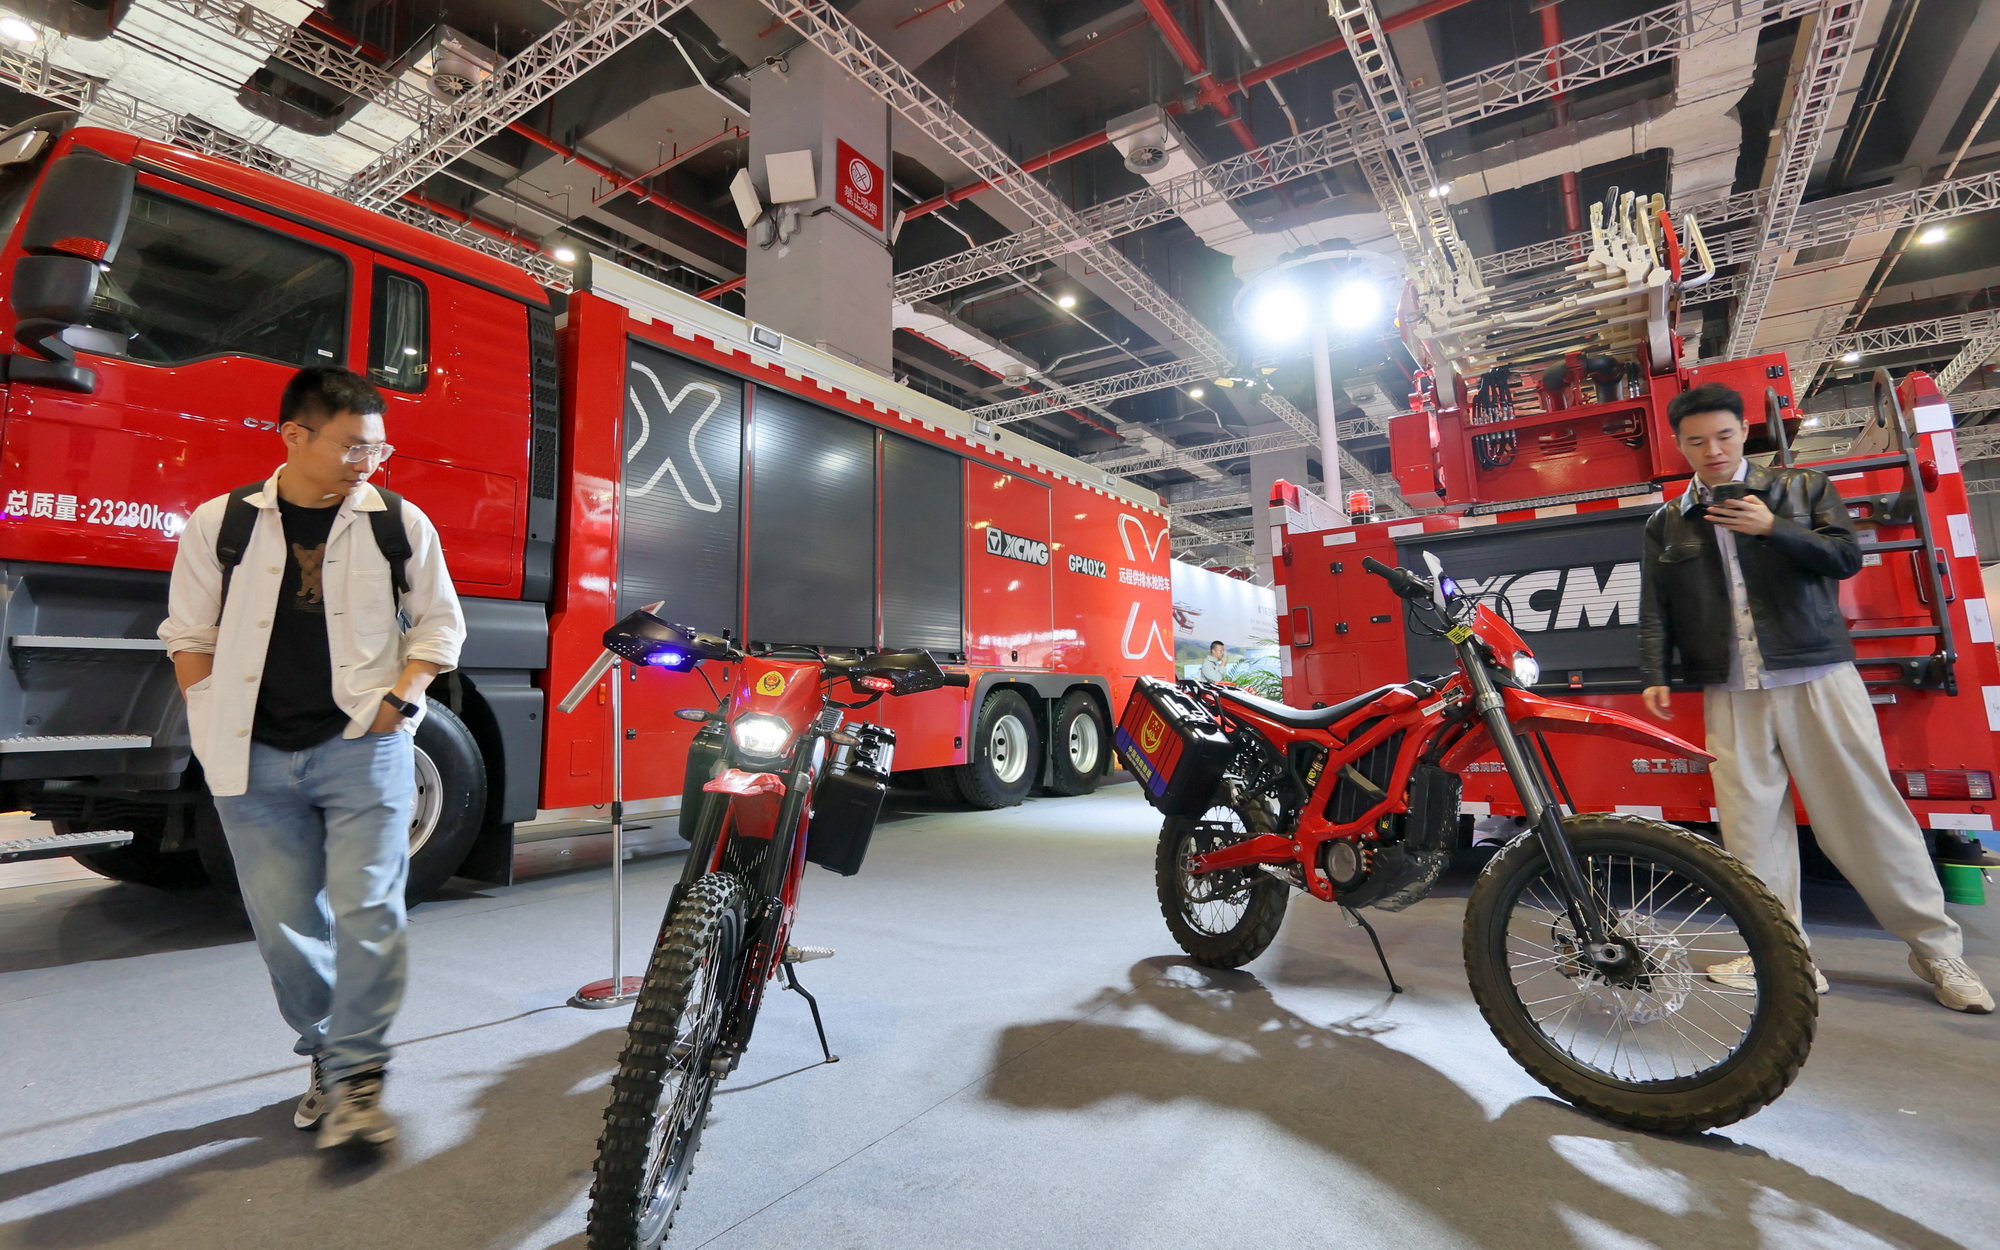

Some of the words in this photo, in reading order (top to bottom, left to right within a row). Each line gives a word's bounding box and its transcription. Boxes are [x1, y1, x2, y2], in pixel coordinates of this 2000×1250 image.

[844, 185, 877, 216] 禁止吸烟
[847, 198, 854, 206] NO
[855, 203, 874, 219] SMOKING
[1002, 534, 1048, 565] XCMG
[1068, 554, 1107, 578] GP40X2
[1118, 566, 1171, 592] 远程供排水抢险车
